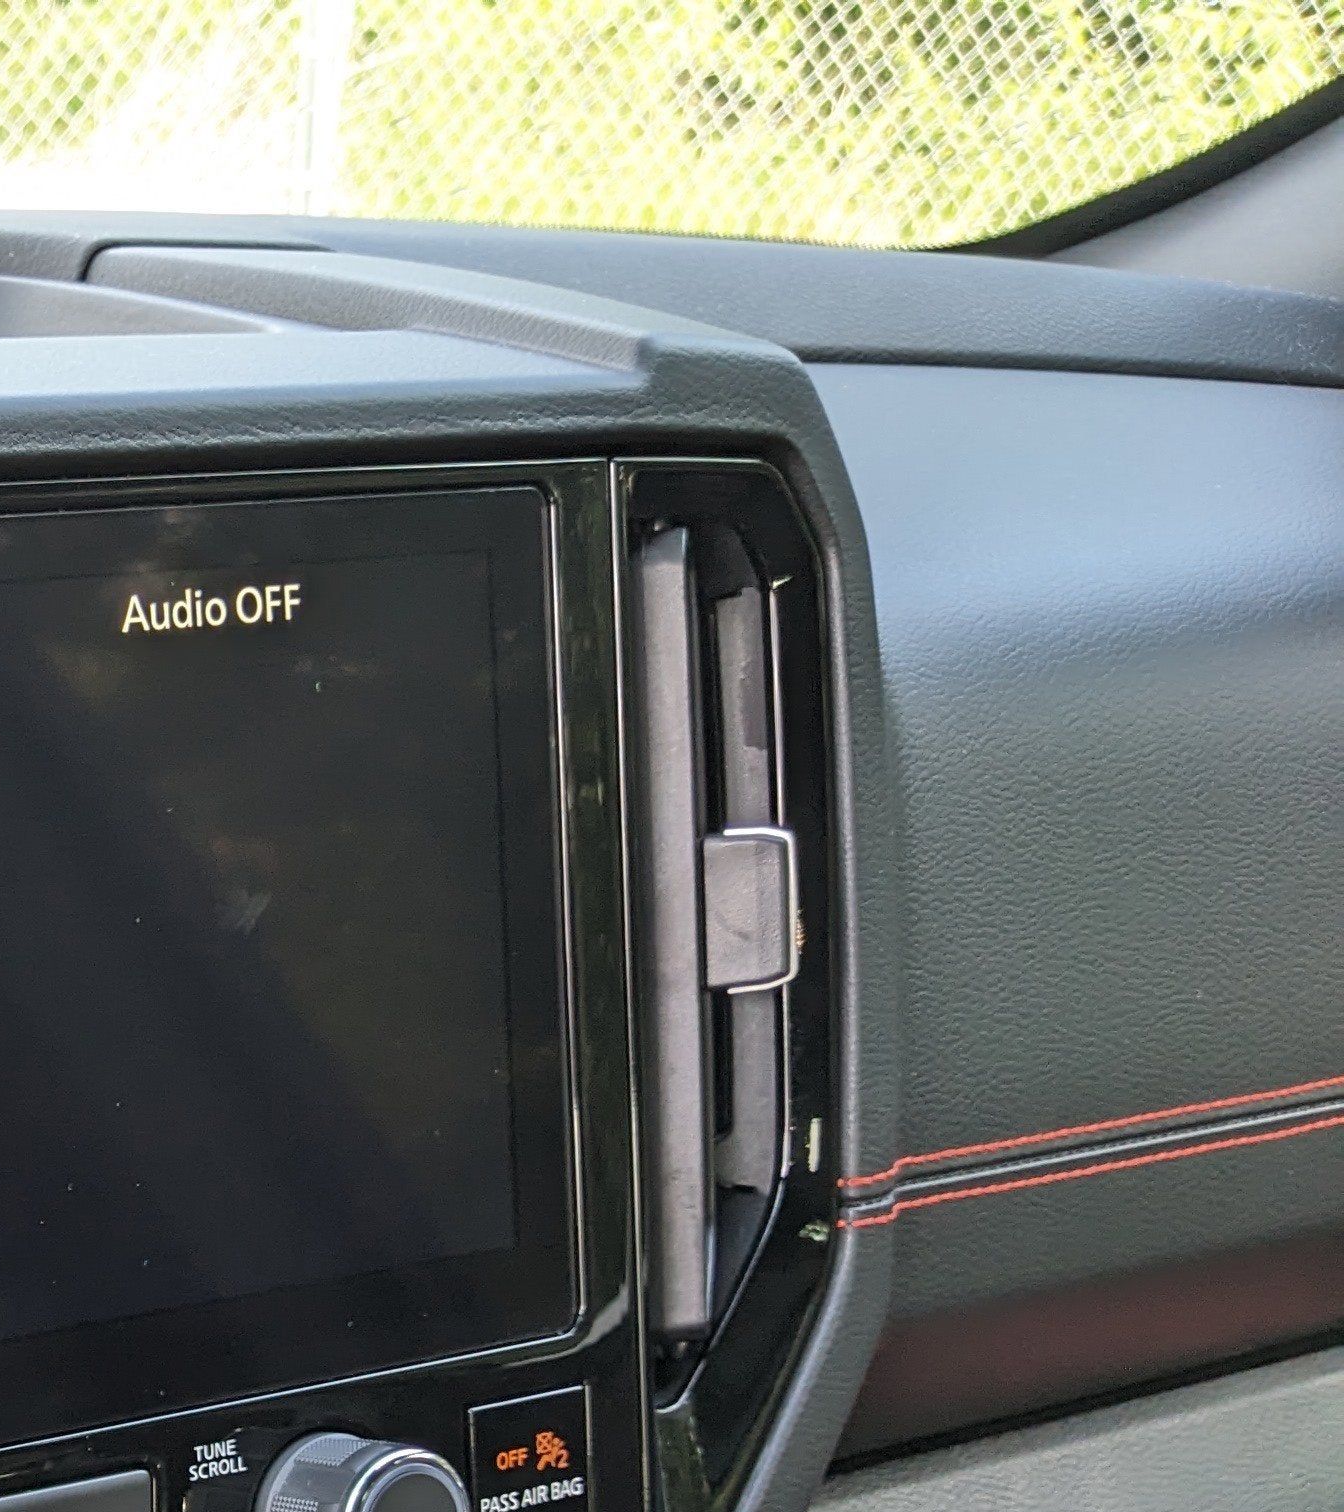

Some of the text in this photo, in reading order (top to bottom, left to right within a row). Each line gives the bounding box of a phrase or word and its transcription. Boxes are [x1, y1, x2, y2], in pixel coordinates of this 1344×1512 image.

[120, 583, 303, 634] Audio OFF
[193, 1438, 238, 1461] TUNE
[495, 1447, 530, 1472] OFF
[188, 1457, 248, 1483] SCROLL
[520, 1483, 549, 1508] AIR
[550, 1475, 585, 1501] BAG
